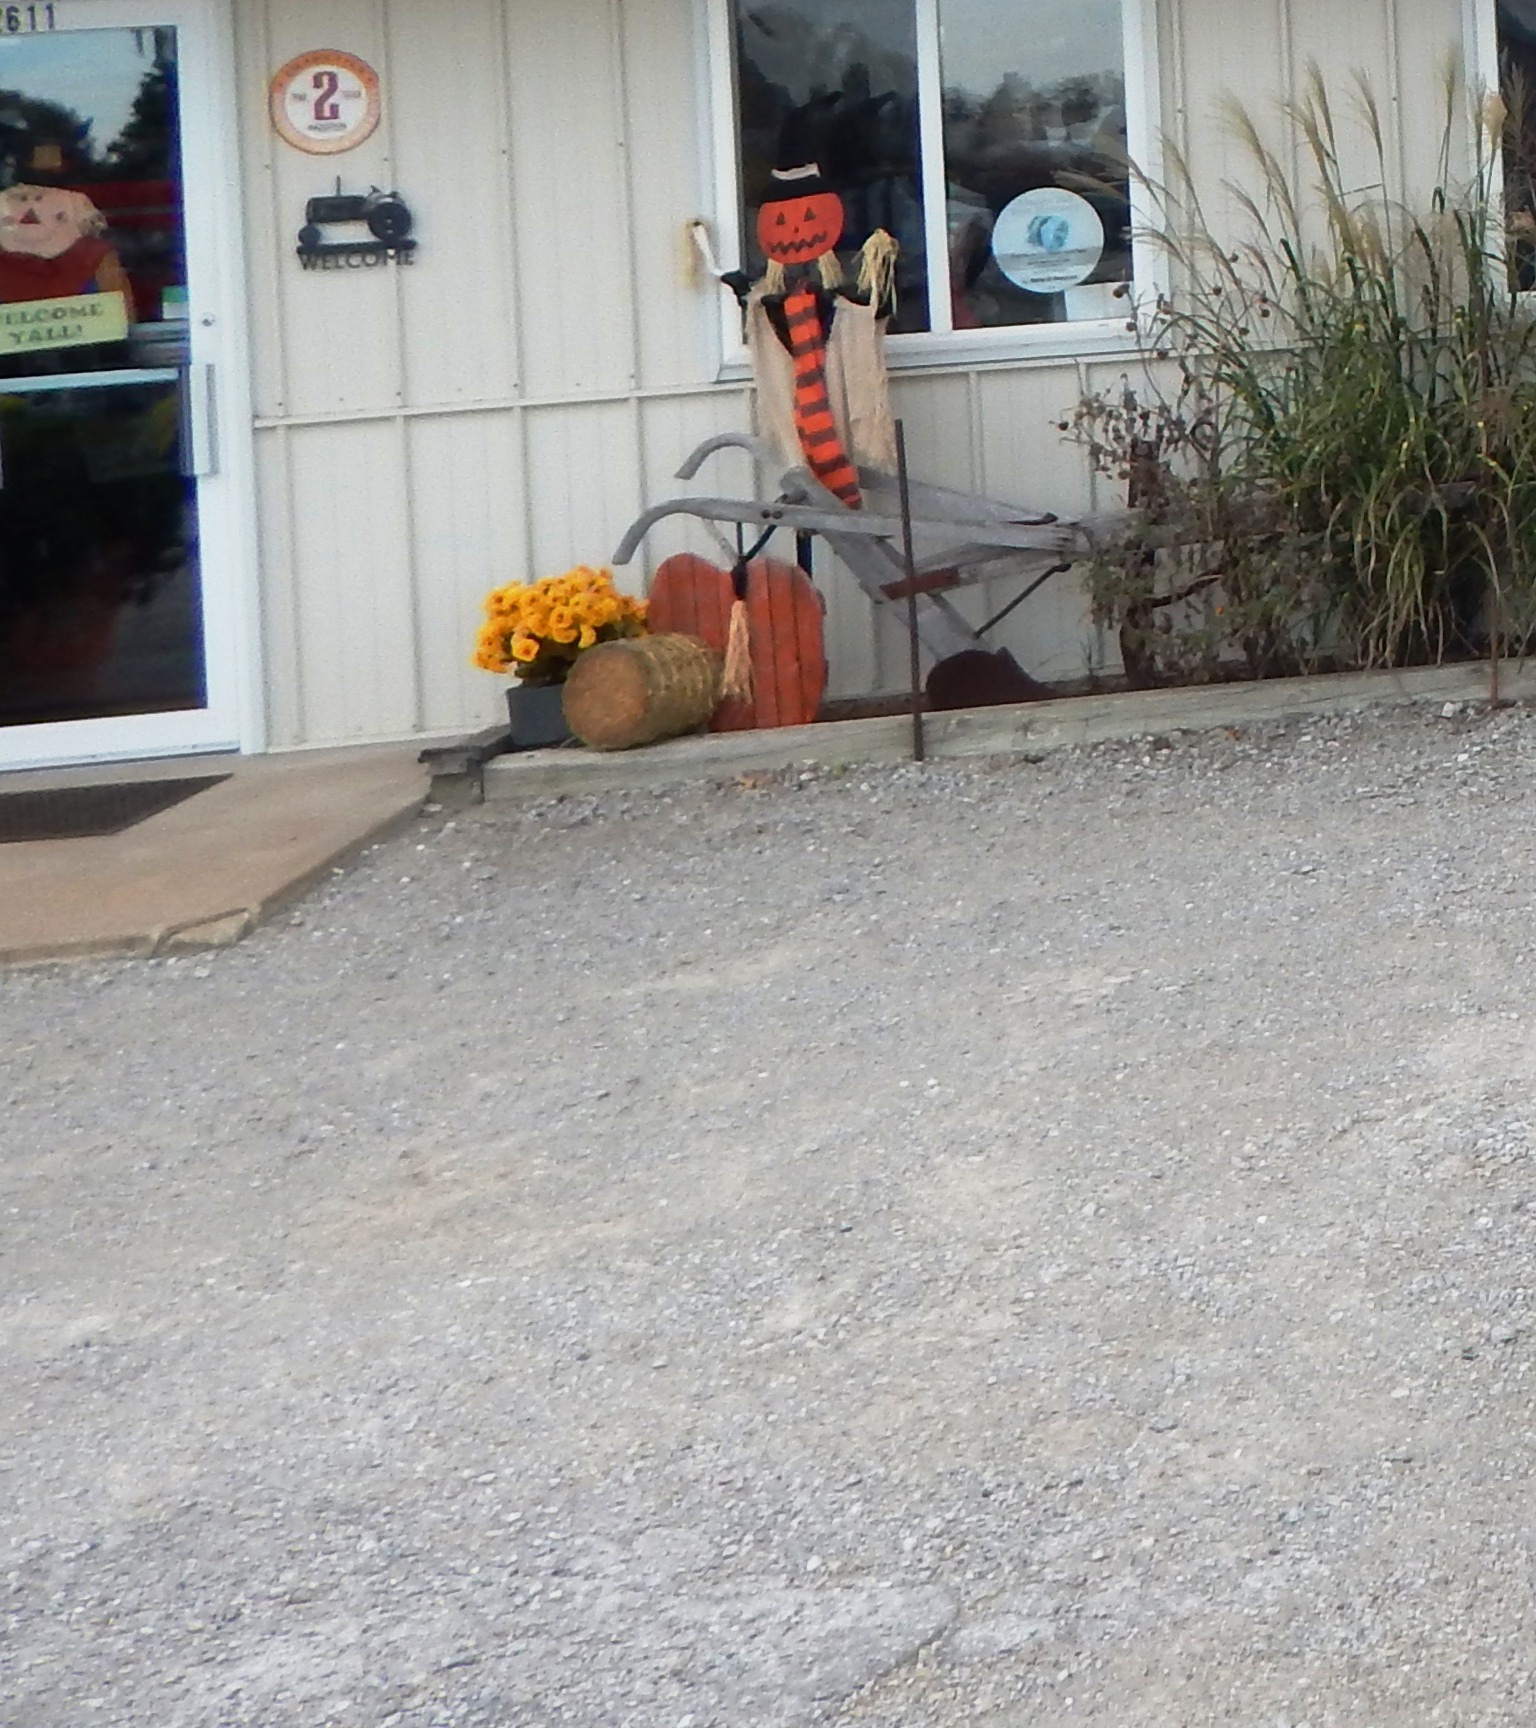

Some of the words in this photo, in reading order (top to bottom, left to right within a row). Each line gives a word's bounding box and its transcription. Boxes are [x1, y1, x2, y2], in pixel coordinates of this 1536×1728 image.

[0, 3, 55, 33] 611
[313, 71, 339, 120] 2
[299, 251, 415, 270] WELCOME
[0, 304, 104, 325] ELCOME
